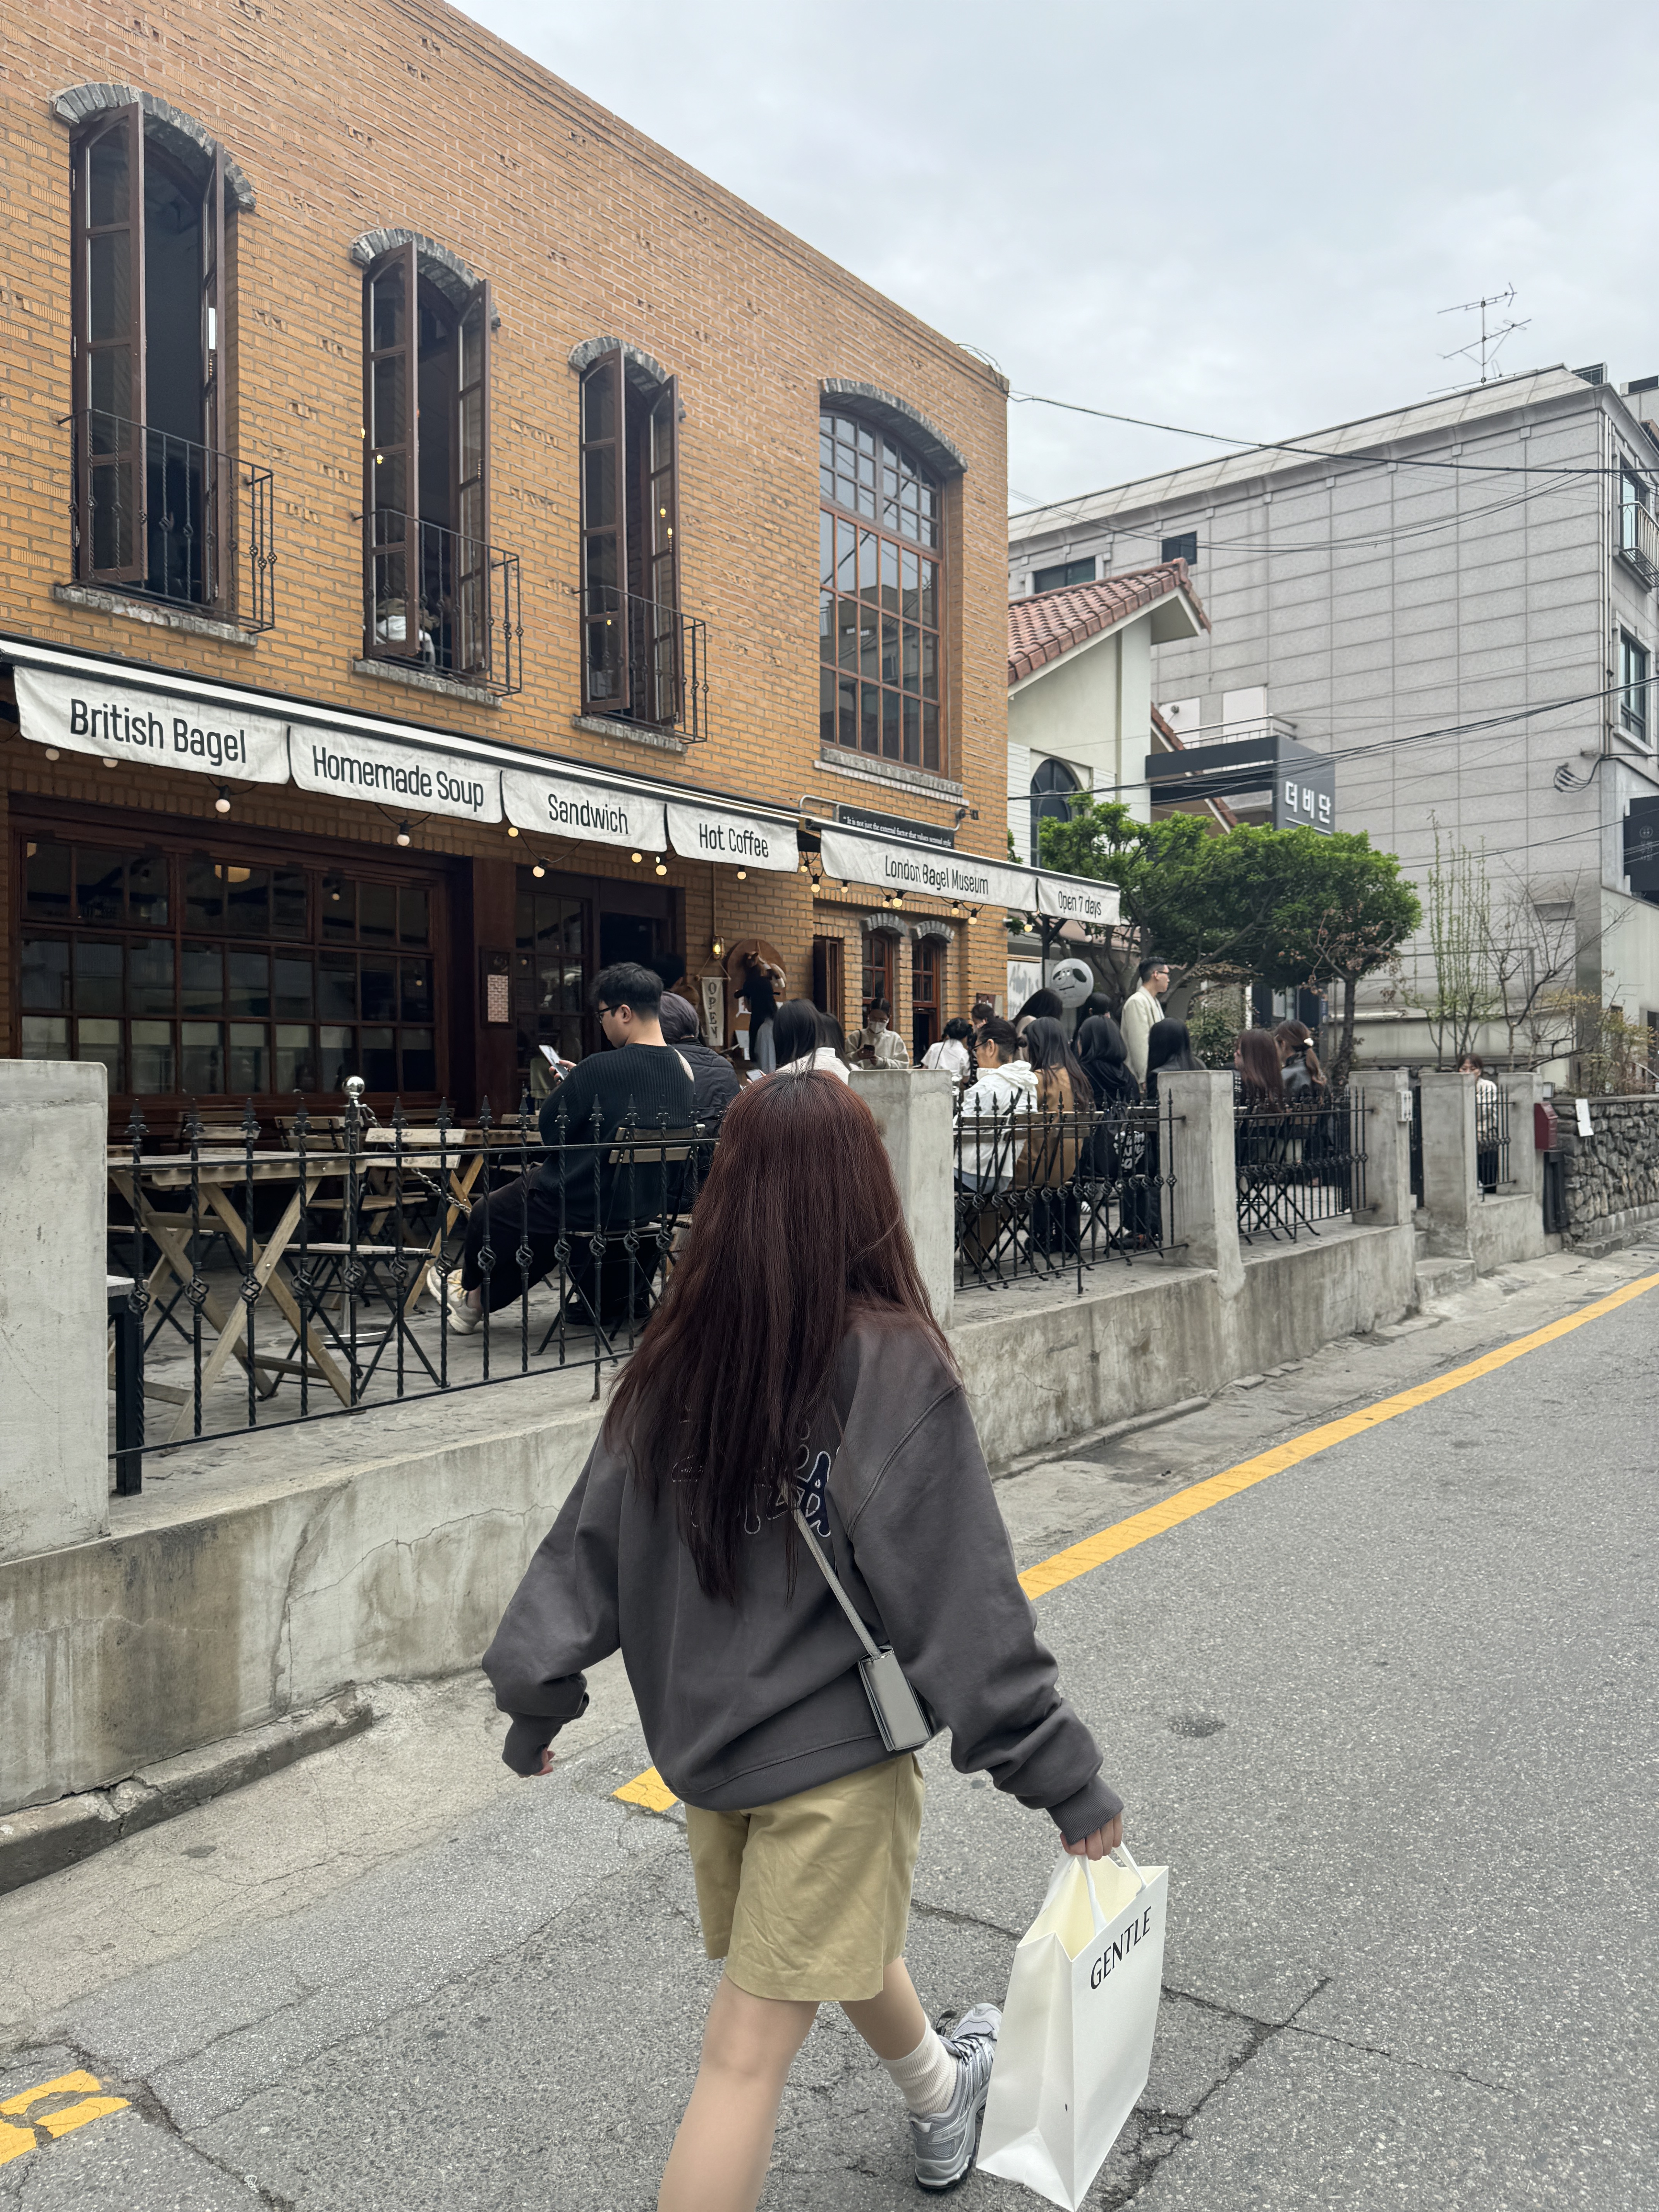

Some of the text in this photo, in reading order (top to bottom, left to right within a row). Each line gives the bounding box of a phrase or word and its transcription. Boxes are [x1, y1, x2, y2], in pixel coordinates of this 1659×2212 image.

[70, 698, 246, 766] British Bagel
[312, 745, 484, 812] Homemade Soup
[548, 793, 629, 835] Sandwich
[1285, 781, 1331, 824] 더비단
[699, 823, 769, 858] Hot Coffee
[885, 855, 989, 895] London Bagel Museum
[1058, 891, 1102, 919] Open 7 days
[1091, 1906, 1151, 1990] GENTLE
